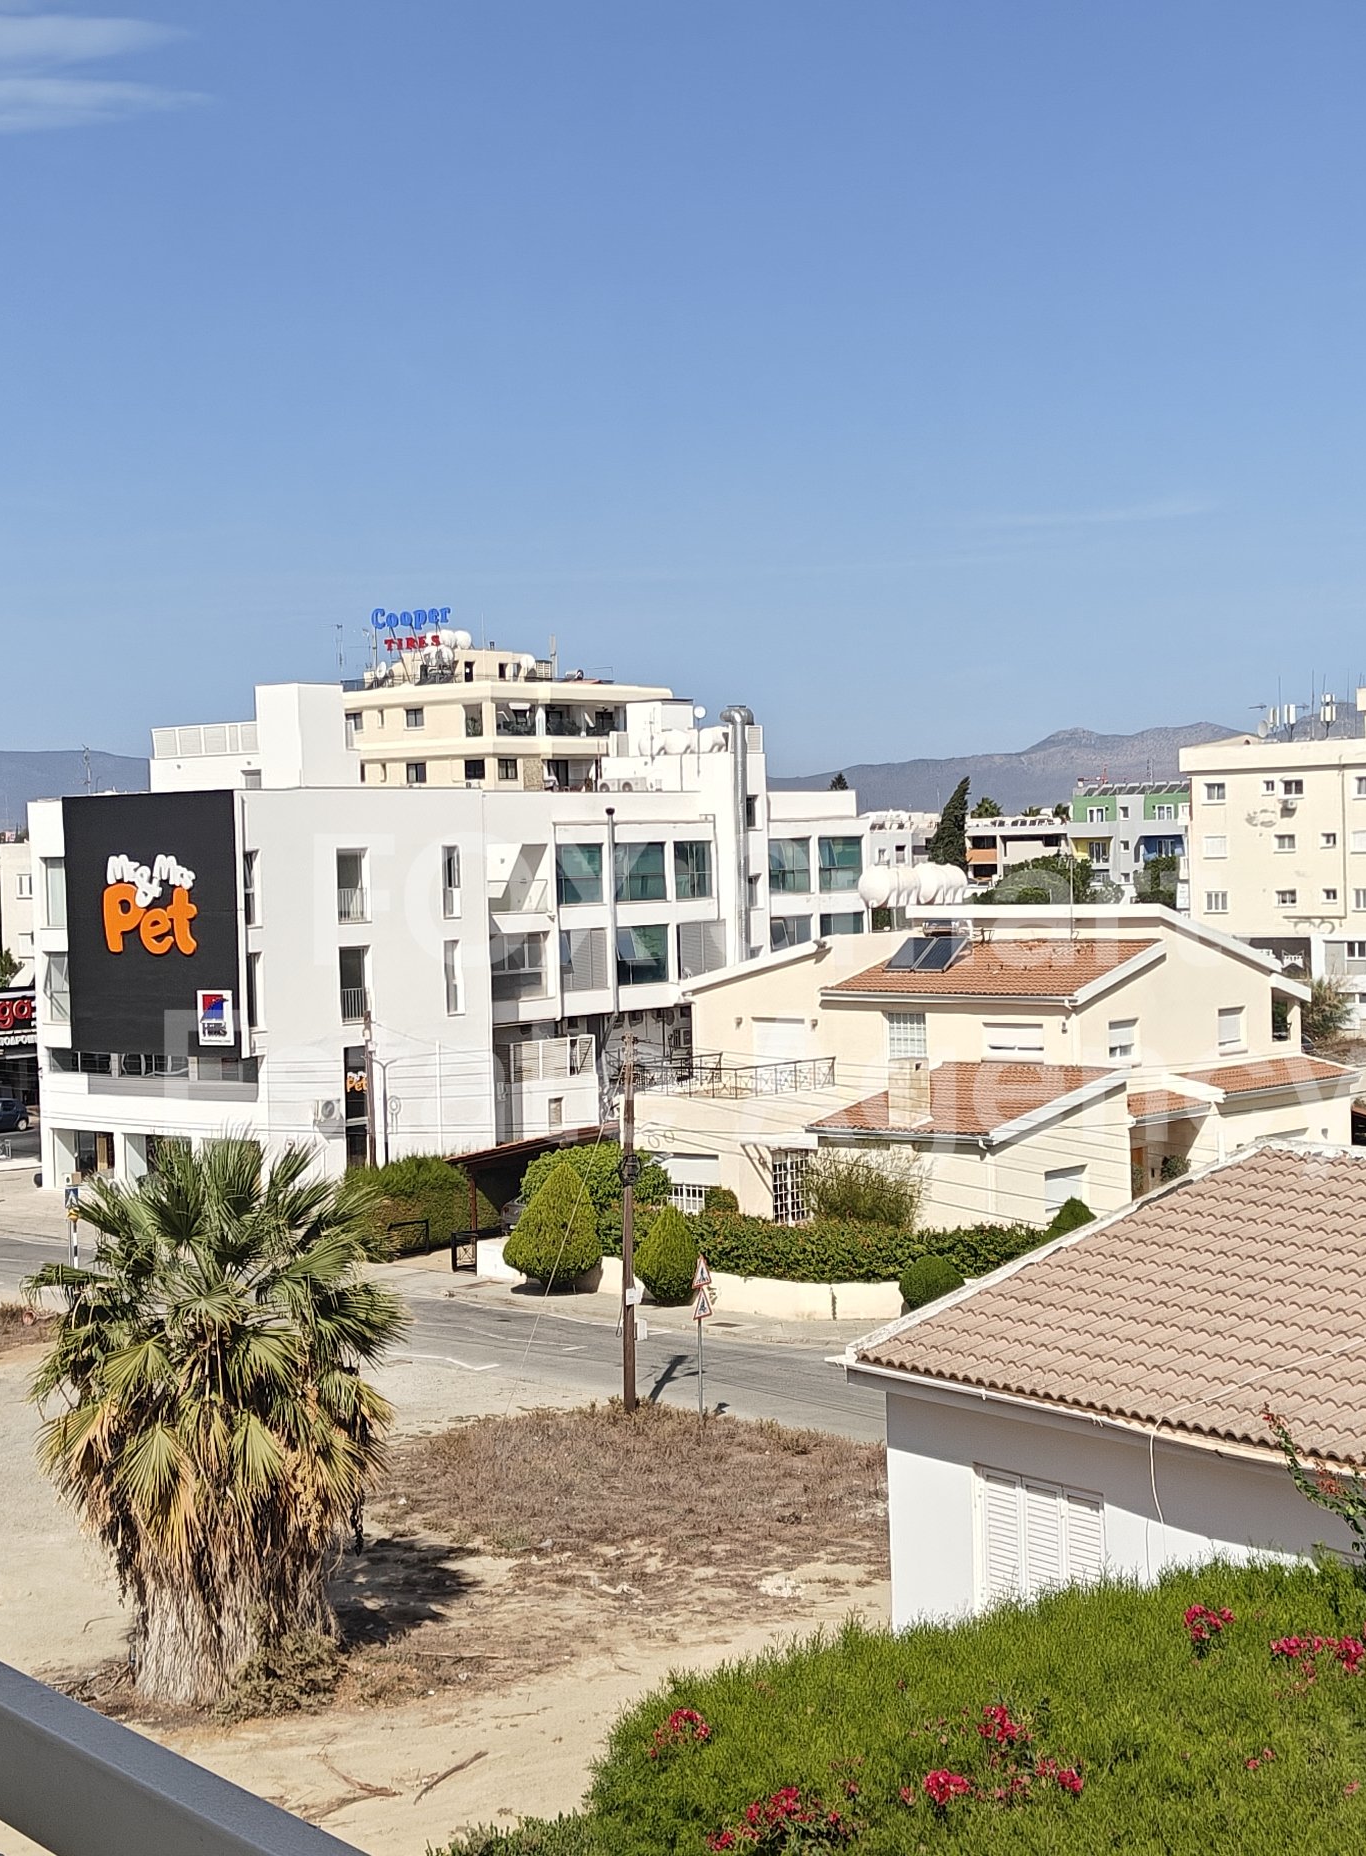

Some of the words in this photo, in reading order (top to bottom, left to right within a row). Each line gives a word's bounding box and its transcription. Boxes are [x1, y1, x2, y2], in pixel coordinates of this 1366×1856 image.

[371, 606, 451, 630] Cooper
[383, 635, 440, 651] TIRES
[106, 854, 140, 884] Mr
[134, 865, 163, 908] &
[152, 854, 196, 890] Mrs
[103, 882, 198, 955] Pet
